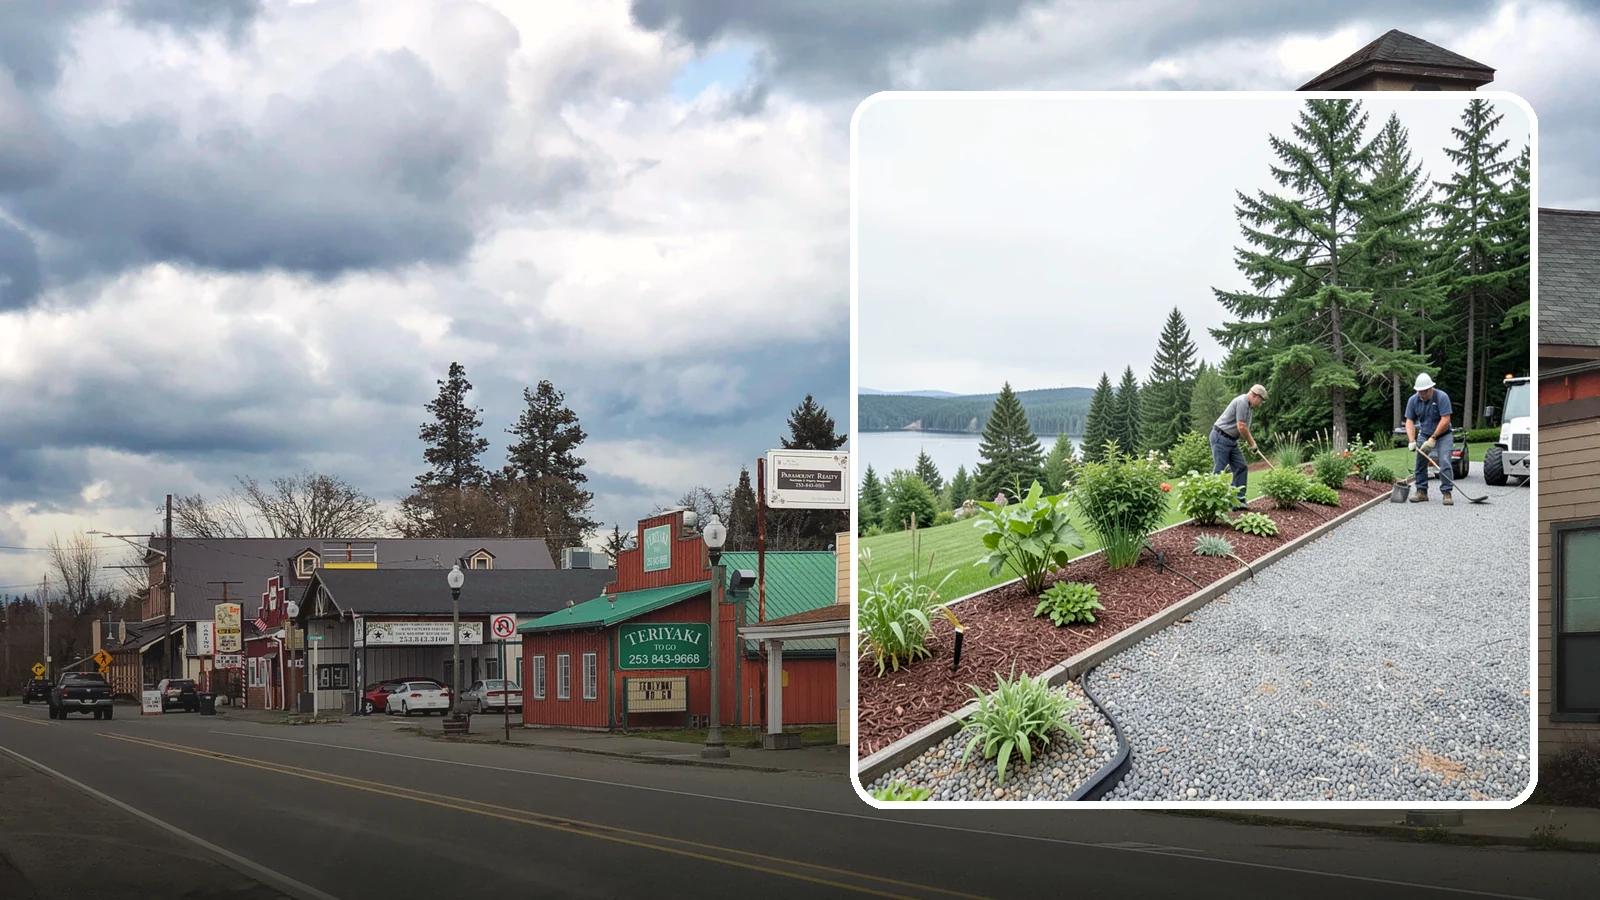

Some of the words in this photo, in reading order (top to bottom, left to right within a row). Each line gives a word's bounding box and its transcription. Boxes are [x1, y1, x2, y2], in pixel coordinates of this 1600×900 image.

[781, 471, 815, 479] PARAMOUNT
[817, 472, 839, 480] REALTY
[624, 627, 702, 646] TERIYAKI
[653, 643, 664, 651] TO
[665, 643, 677, 651] GO
[628, 654, 648, 664] 253
[651, 653, 700, 664] 843-9668
